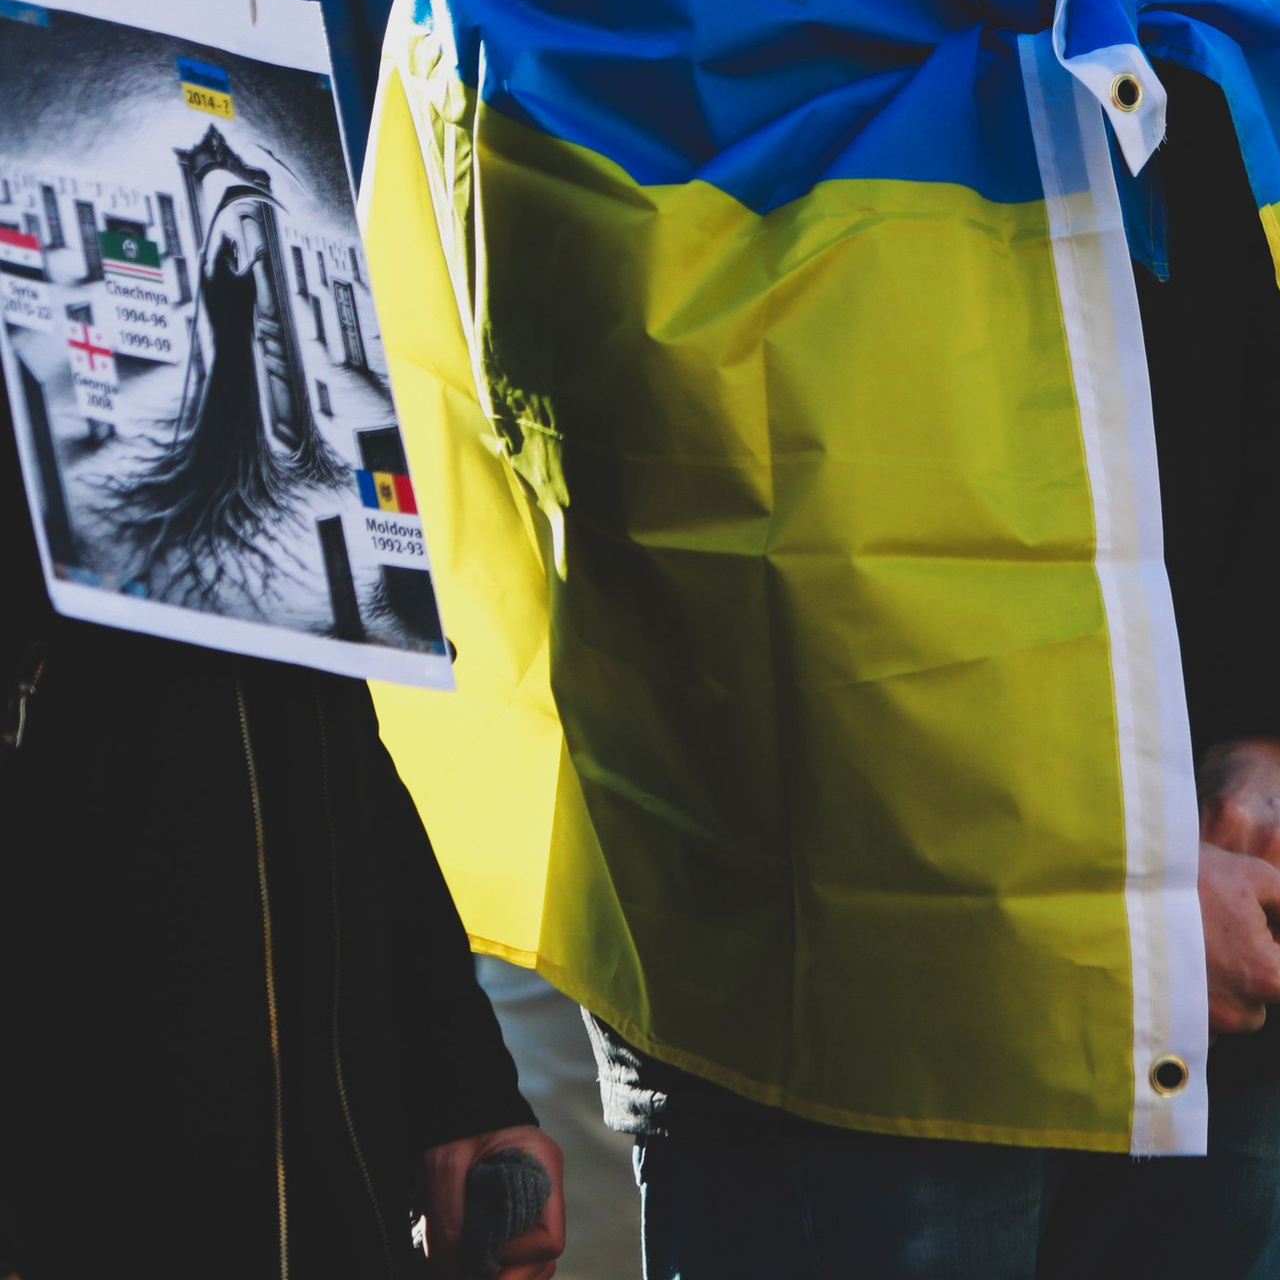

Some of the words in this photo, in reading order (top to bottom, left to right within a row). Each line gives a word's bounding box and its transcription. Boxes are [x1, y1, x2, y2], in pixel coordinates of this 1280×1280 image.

[8, 281, 39, 301] Syria
[105, 280, 168, 307] Chechnya
[115, 306, 168, 329] 1994-96
[119, 330, 172, 353] 1999-09
[73, 372, 119, 397] Georgia
[86, 392, 114, 411] 2008
[365, 517, 423, 540] Moldova
[371, 535, 425, 557] 1992-93
